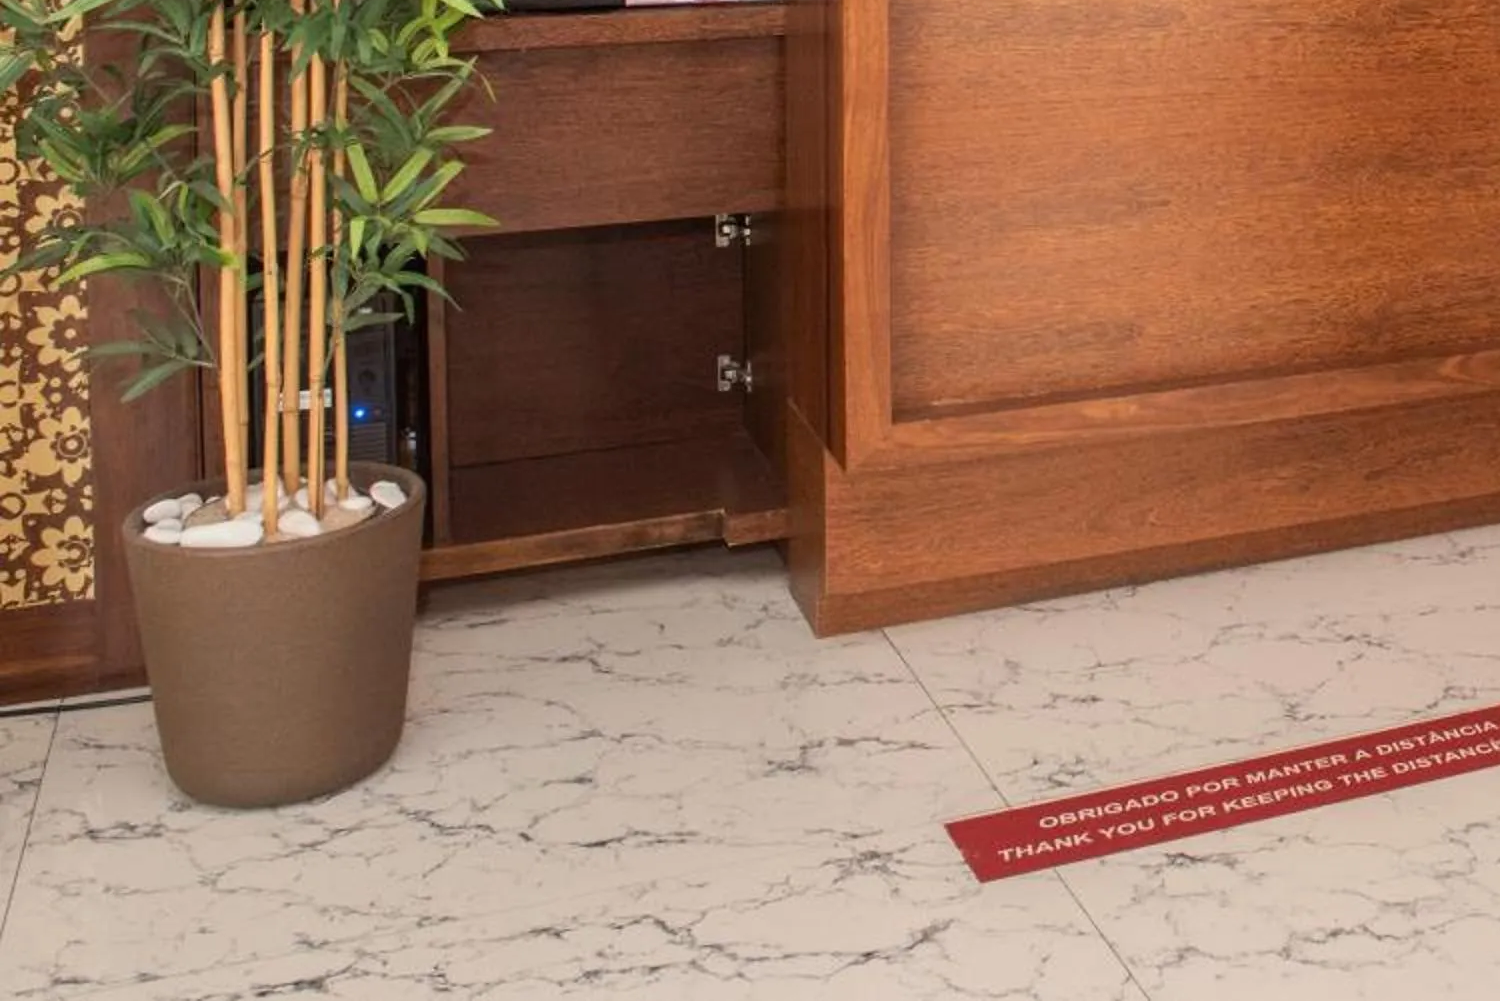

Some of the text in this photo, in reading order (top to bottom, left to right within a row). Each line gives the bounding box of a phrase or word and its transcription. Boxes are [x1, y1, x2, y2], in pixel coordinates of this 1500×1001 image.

[998, 831, 1094, 862] THANK
[1099, 817, 1154, 839] YOU
[1163, 805, 1217, 826] FOR
[1221, 779, 1333, 814] KEEPING
[1338, 766, 1388, 787] THE
[1039, 790, 1179, 829] OBRIGADO
[1185, 776, 1241, 798] POR
[1246, 753, 1348, 785] MANTER
[1354, 749, 1373, 761] A
